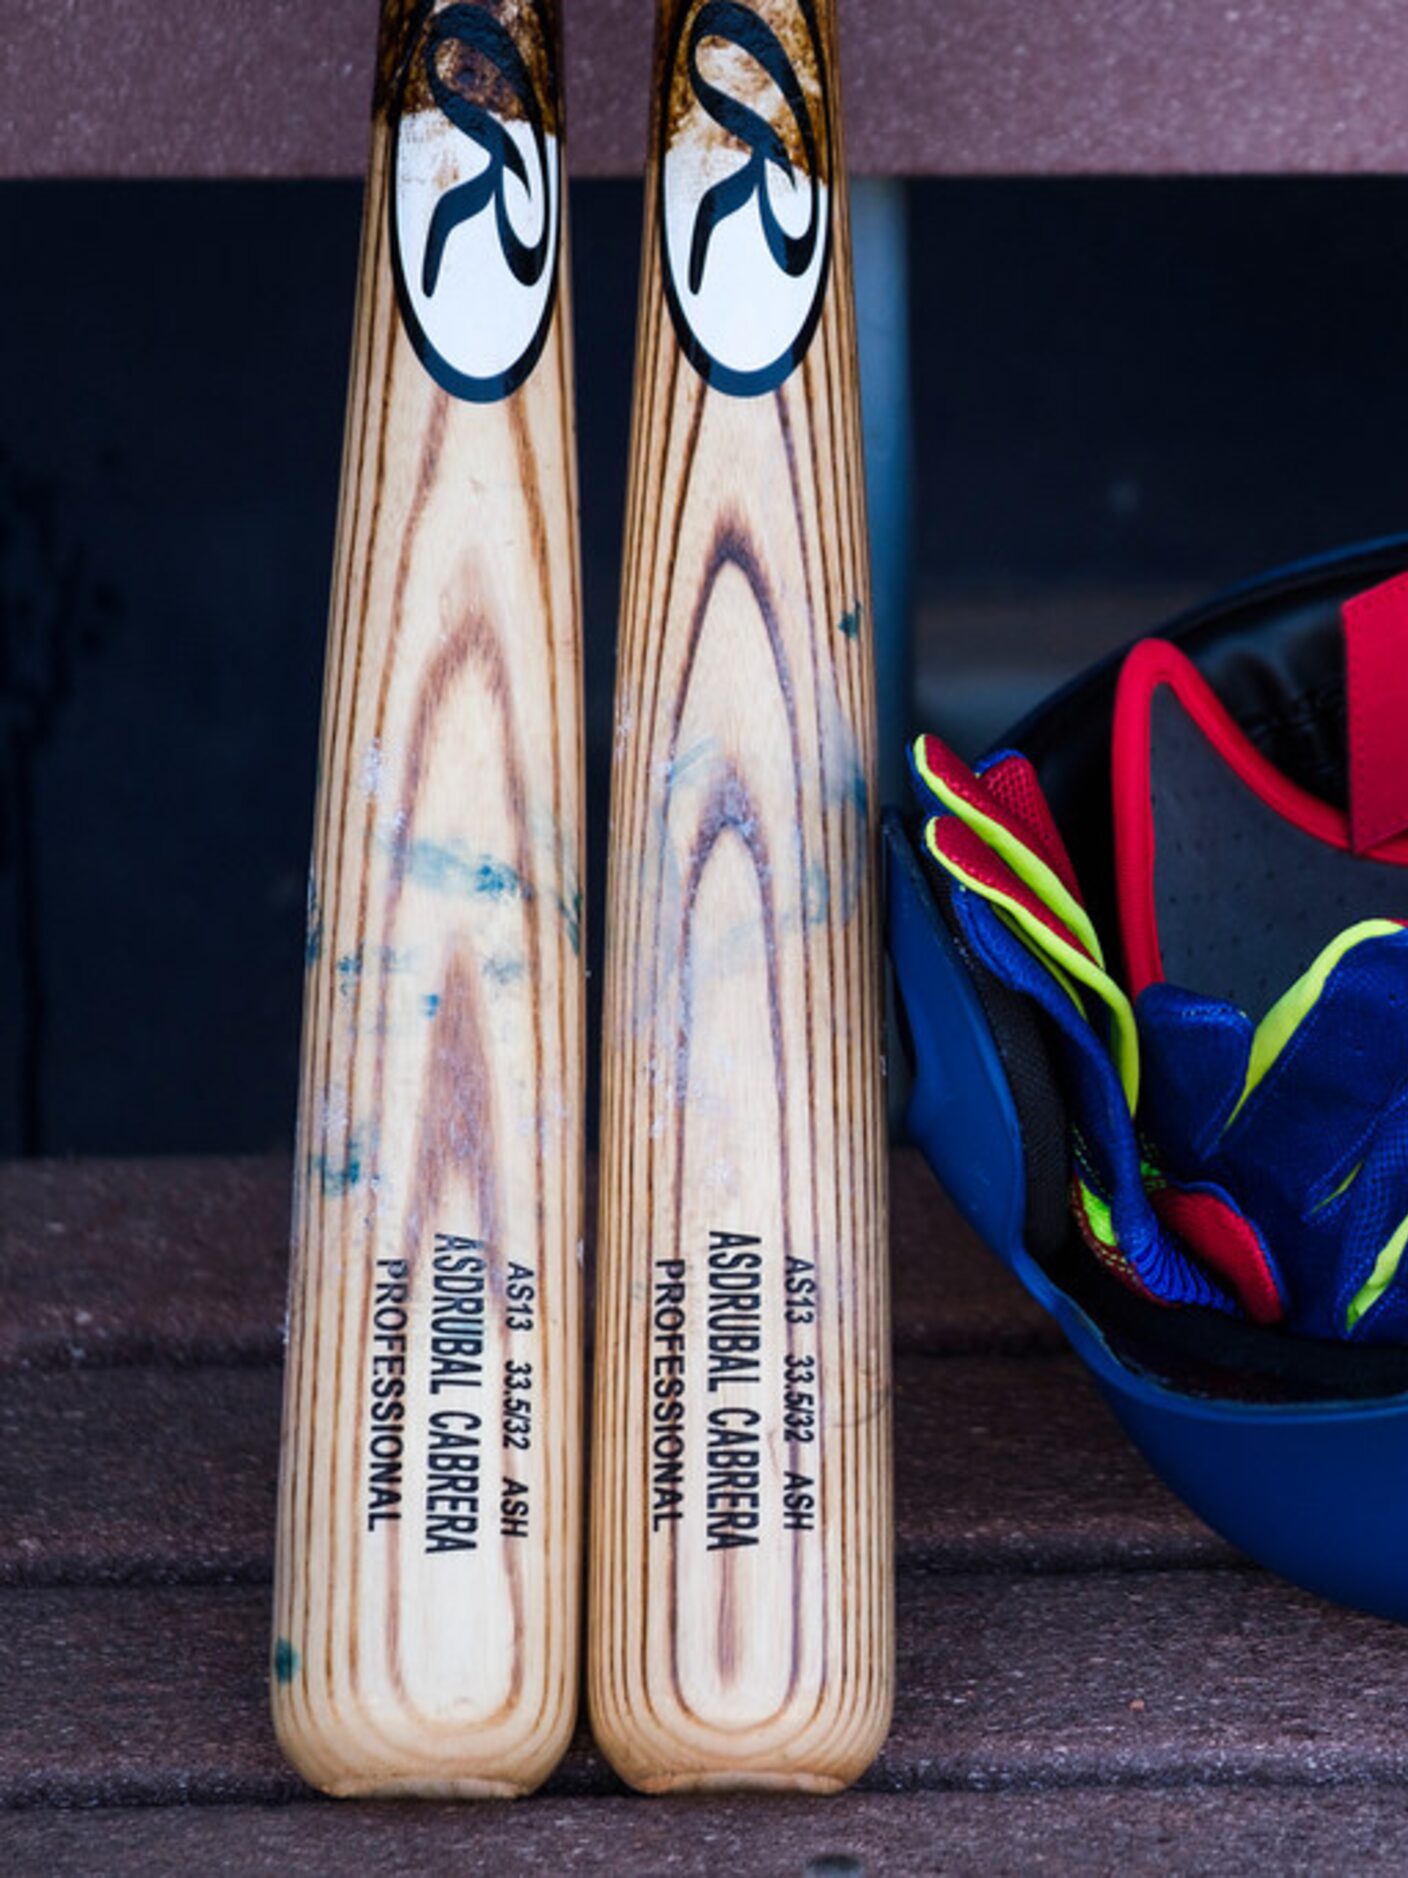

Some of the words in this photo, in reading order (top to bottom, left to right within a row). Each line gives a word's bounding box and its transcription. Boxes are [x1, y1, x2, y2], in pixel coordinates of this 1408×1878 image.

[430, 1233, 486, 1395] ASDRUBAL
[505, 1261, 534, 1331] AS13
[707, 1231, 762, 1393] ASDRUBAL
[784, 1256, 816, 1326] AS13
[368, 1259, 409, 1532] PROFESSIONAL
[503, 1359, 532, 1450] 33.5/32
[653, 1259, 686, 1532] PROFESSIONAL
[783, 1354, 815, 1444] 33.5/32
[425, 1411, 482, 1554] CABRERA
[500, 1476, 529, 1537] ASH
[706, 1407, 761, 1552] CABRERA
[783, 1470, 815, 1531] ASH
